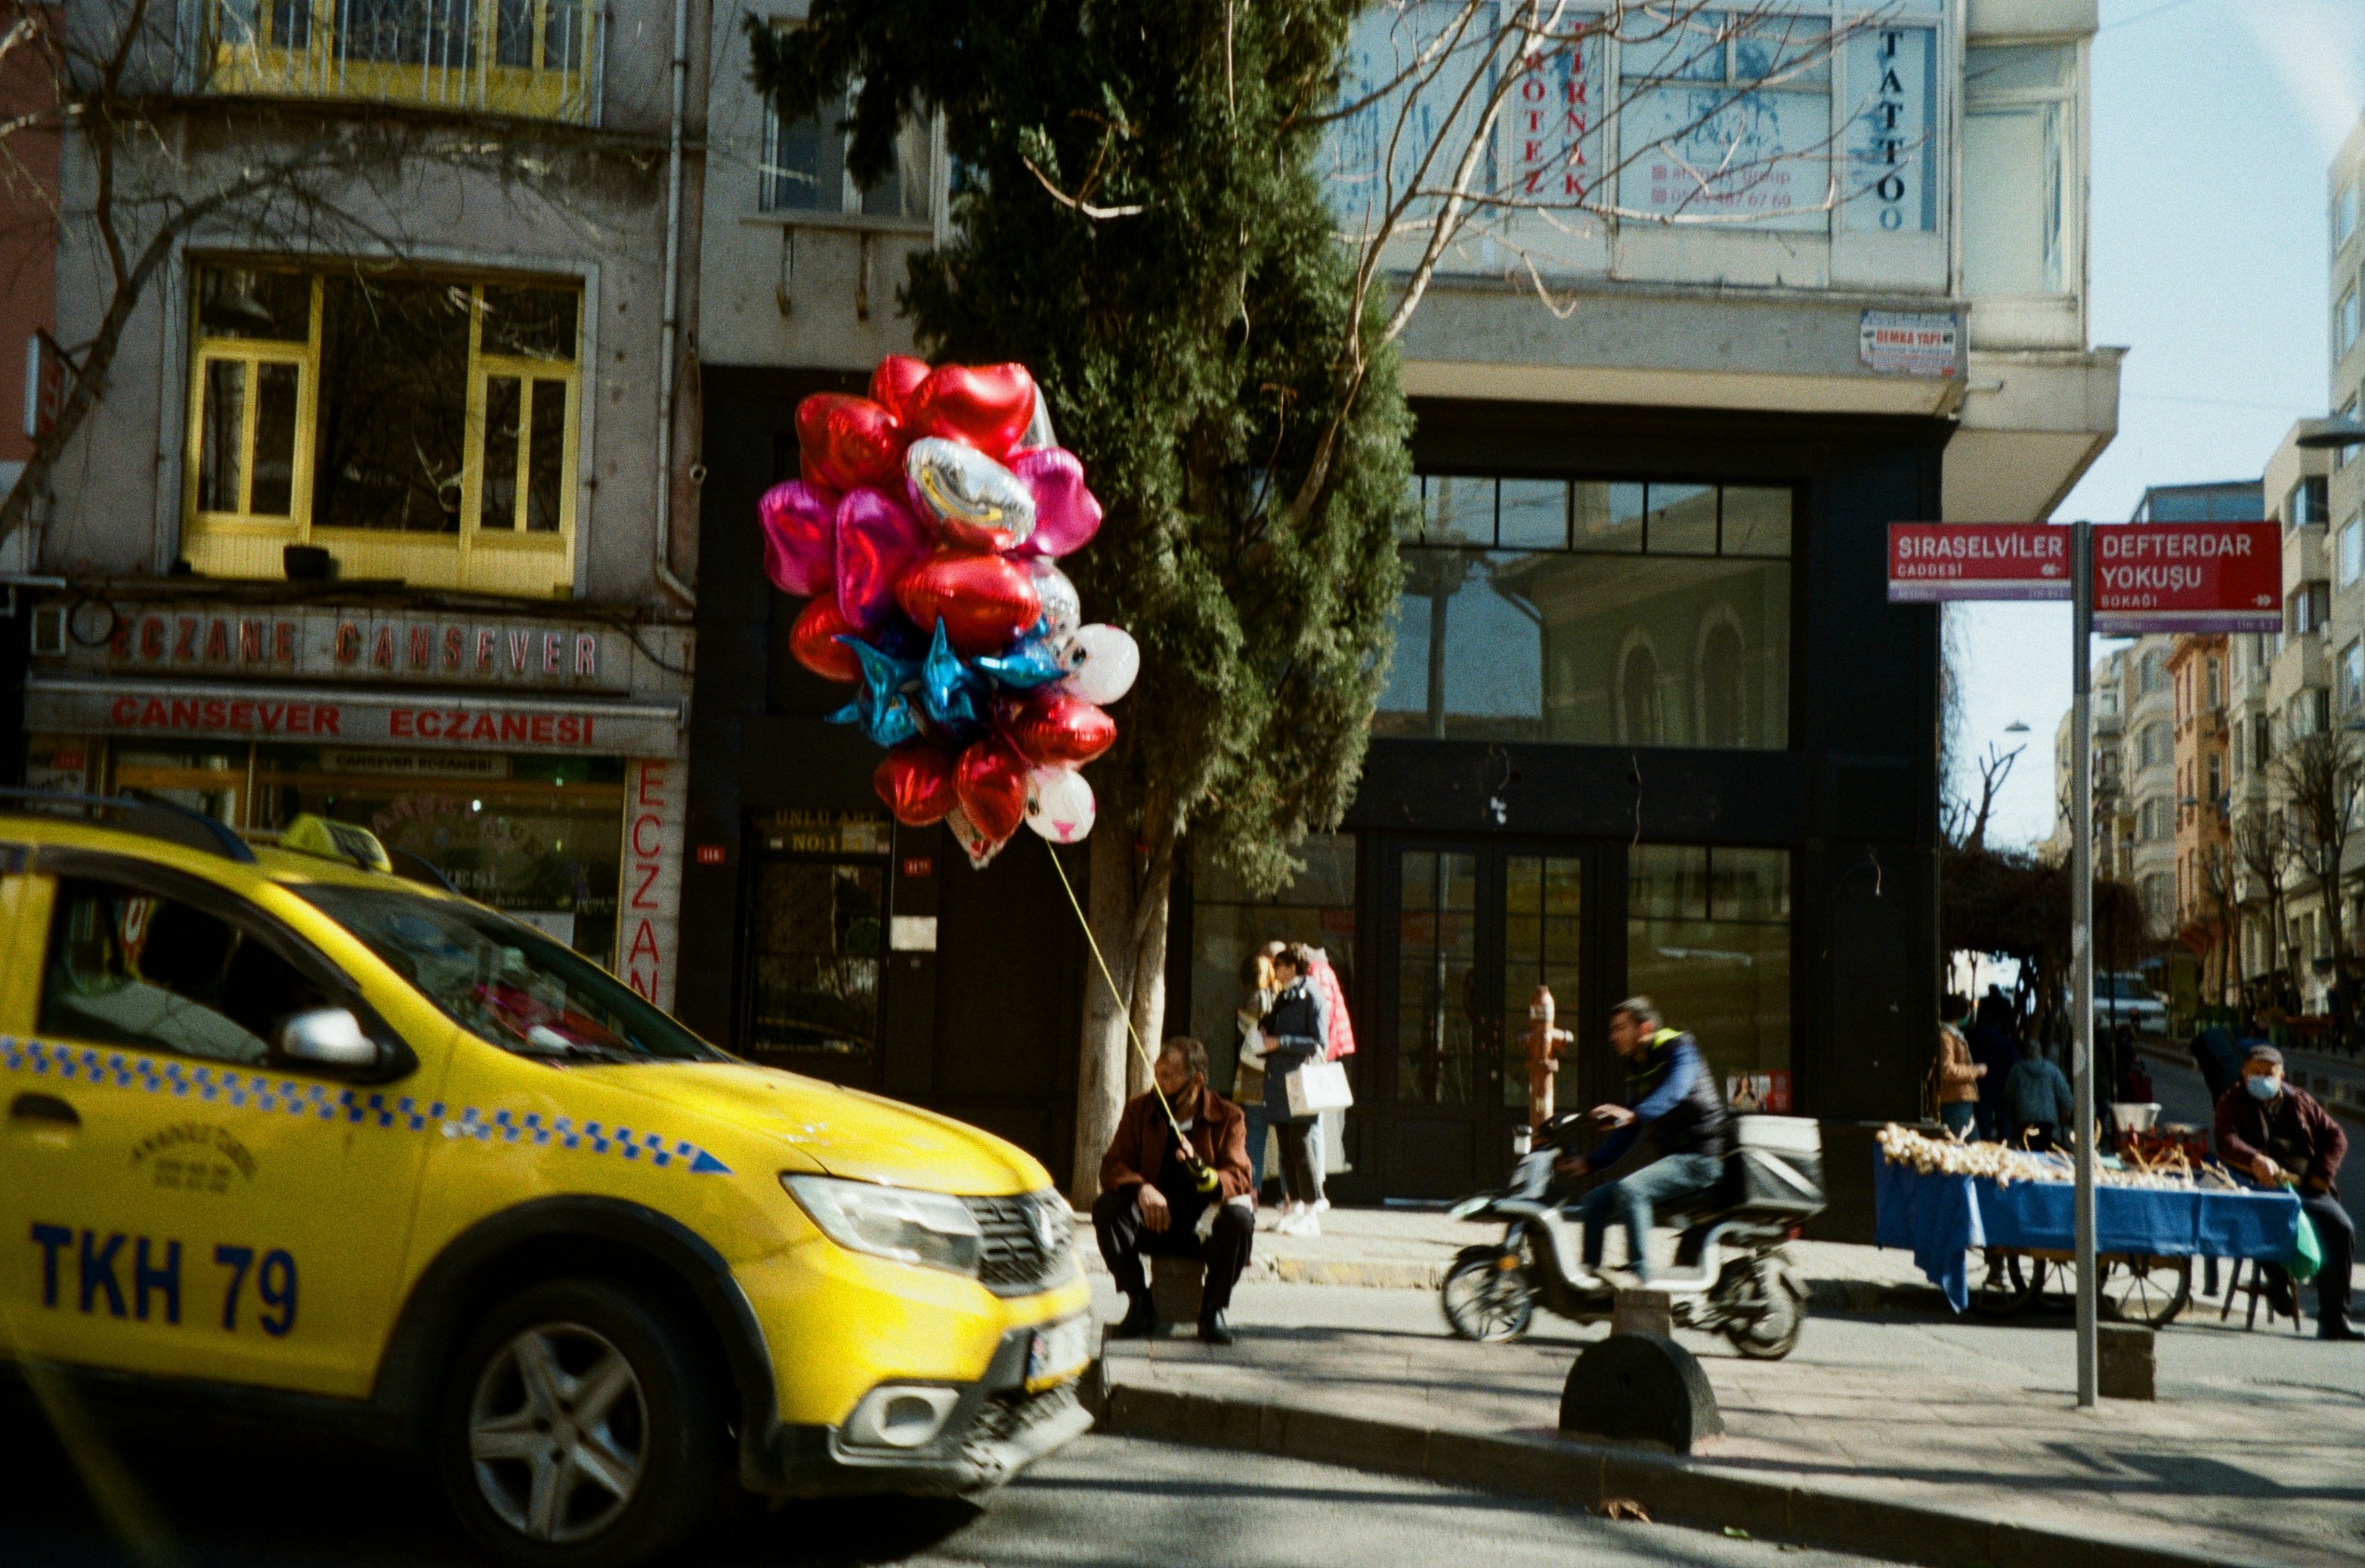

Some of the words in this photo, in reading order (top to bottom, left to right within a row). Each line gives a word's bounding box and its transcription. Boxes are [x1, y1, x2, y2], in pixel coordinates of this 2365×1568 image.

[1522, 21, 1546, 194] ROTEZ
[1565, 21, 1588, 196] TIRNAK
[1877, 30, 1905, 231] TATTOO
[1898, 532, 2064, 559] SIRASELVİLER
[2102, 533, 2252, 558] DEFTERDAR
[2101, 565, 2202, 592] YOKUŞU
[111, 615, 295, 663] ECZANE
[336, 618, 595, 676] CANSEVER
[113, 697, 341, 735] CANSEVER
[29, 1222, 181, 1325] TKH
[214, 1243, 298, 1339] 79
